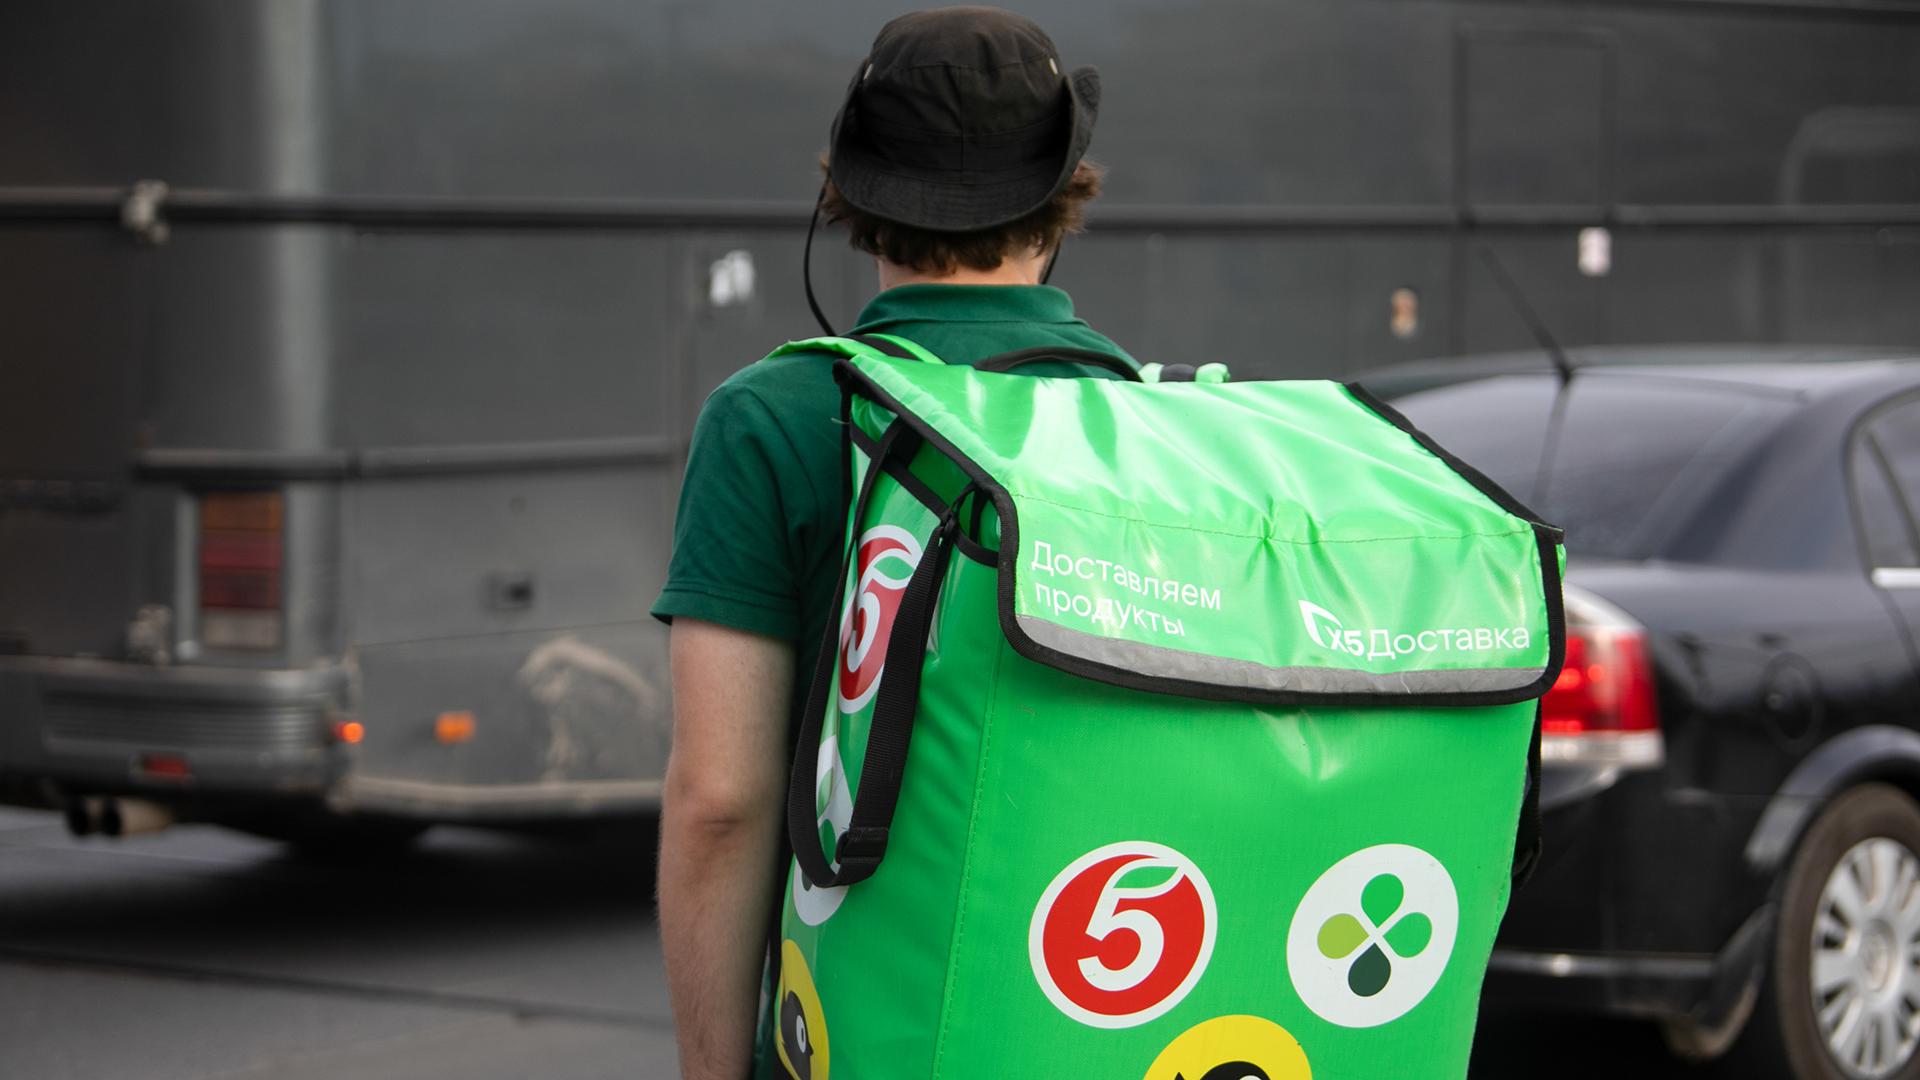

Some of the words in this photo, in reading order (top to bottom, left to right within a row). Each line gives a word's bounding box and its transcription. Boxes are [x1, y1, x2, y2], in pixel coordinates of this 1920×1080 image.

[1031, 540, 1221, 610] Доставляем
[1035, 582, 1185, 636] продукты
[1077, 857, 1184, 992] 5
